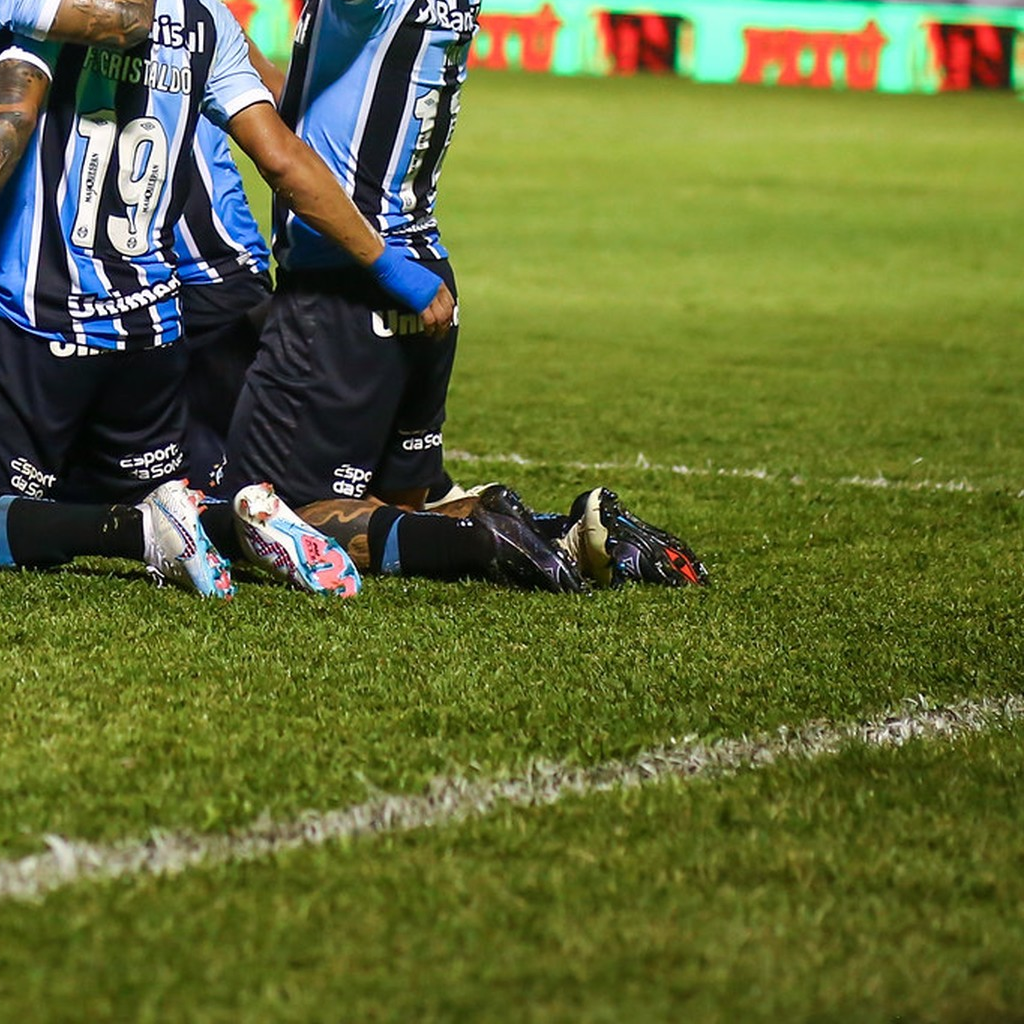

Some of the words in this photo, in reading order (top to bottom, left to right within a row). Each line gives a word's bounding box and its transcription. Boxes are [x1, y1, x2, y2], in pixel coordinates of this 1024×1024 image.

[70, 108, 169, 258] 19
[10, 457, 57, 488] Esport
[334, 464, 373, 484] Espo
